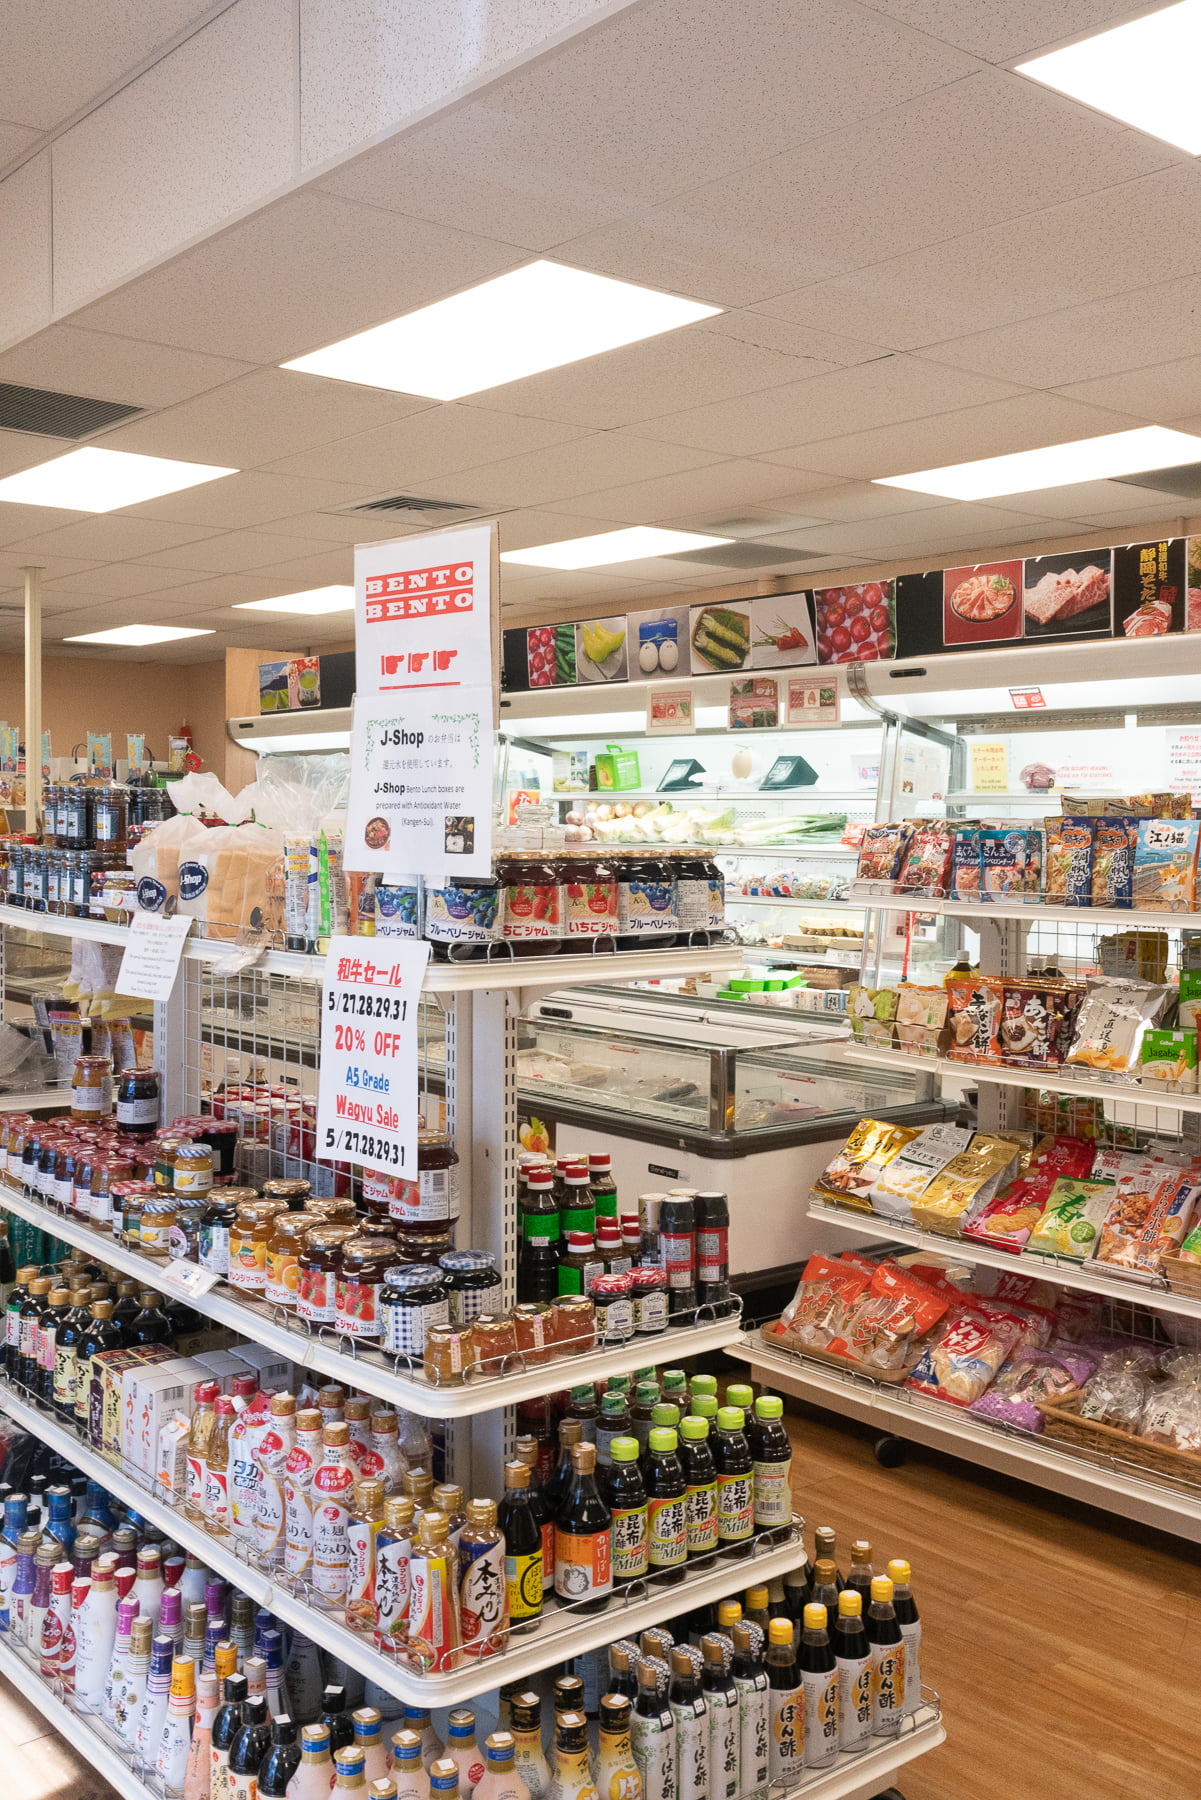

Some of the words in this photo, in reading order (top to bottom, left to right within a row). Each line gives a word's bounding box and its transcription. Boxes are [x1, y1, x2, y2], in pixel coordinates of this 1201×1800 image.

[366, 566, 473, 594] BENTO
[366, 592, 473, 619] BENTO
[380, 729, 425, 748] J-Shop
[374, 782, 405, 795] J-Shop
[422, 785, 437, 793] Lunch
[438, 784, 453, 793] boxes
[376, 802, 401, 811] prepared
[402, 801, 413, 809] with
[413, 801, 442, 810] Antioxidant
[444, 800, 461, 809] Water
[336, 957, 402, 985] 和牛セール
[328, 992, 407, 1021] 5/27.28.29.31
[334, 1025, 366, 1052] 20%
[374, 1031, 401, 1059] OFF
[346, 1066, 360, 1087] A5
[363, 1068, 390, 1092] Grade
[336, 1095, 373, 1123] Wagyu
[376, 1103, 399, 1129] Sale
[325, 1128, 405, 1167] 5/27.28.29.31
[696, 1491, 709, 1522] 昆布
[733, 1480, 747, 1511] 昆布
[626, 1513, 640, 1547] 昆布
[672, 1502, 683, 1535] 昆布
[725, 1519, 750, 1535] Mild
[651, 1540, 675, 1553] Super
[616, 1555, 644, 1572] Mild
[376, 1553, 398, 1618] 本みりん
[473, 1559, 499, 1623] 本みりん
[878, 1659, 897, 1710] ぽん酢
[779, 1705, 798, 1758] ぽん酢
